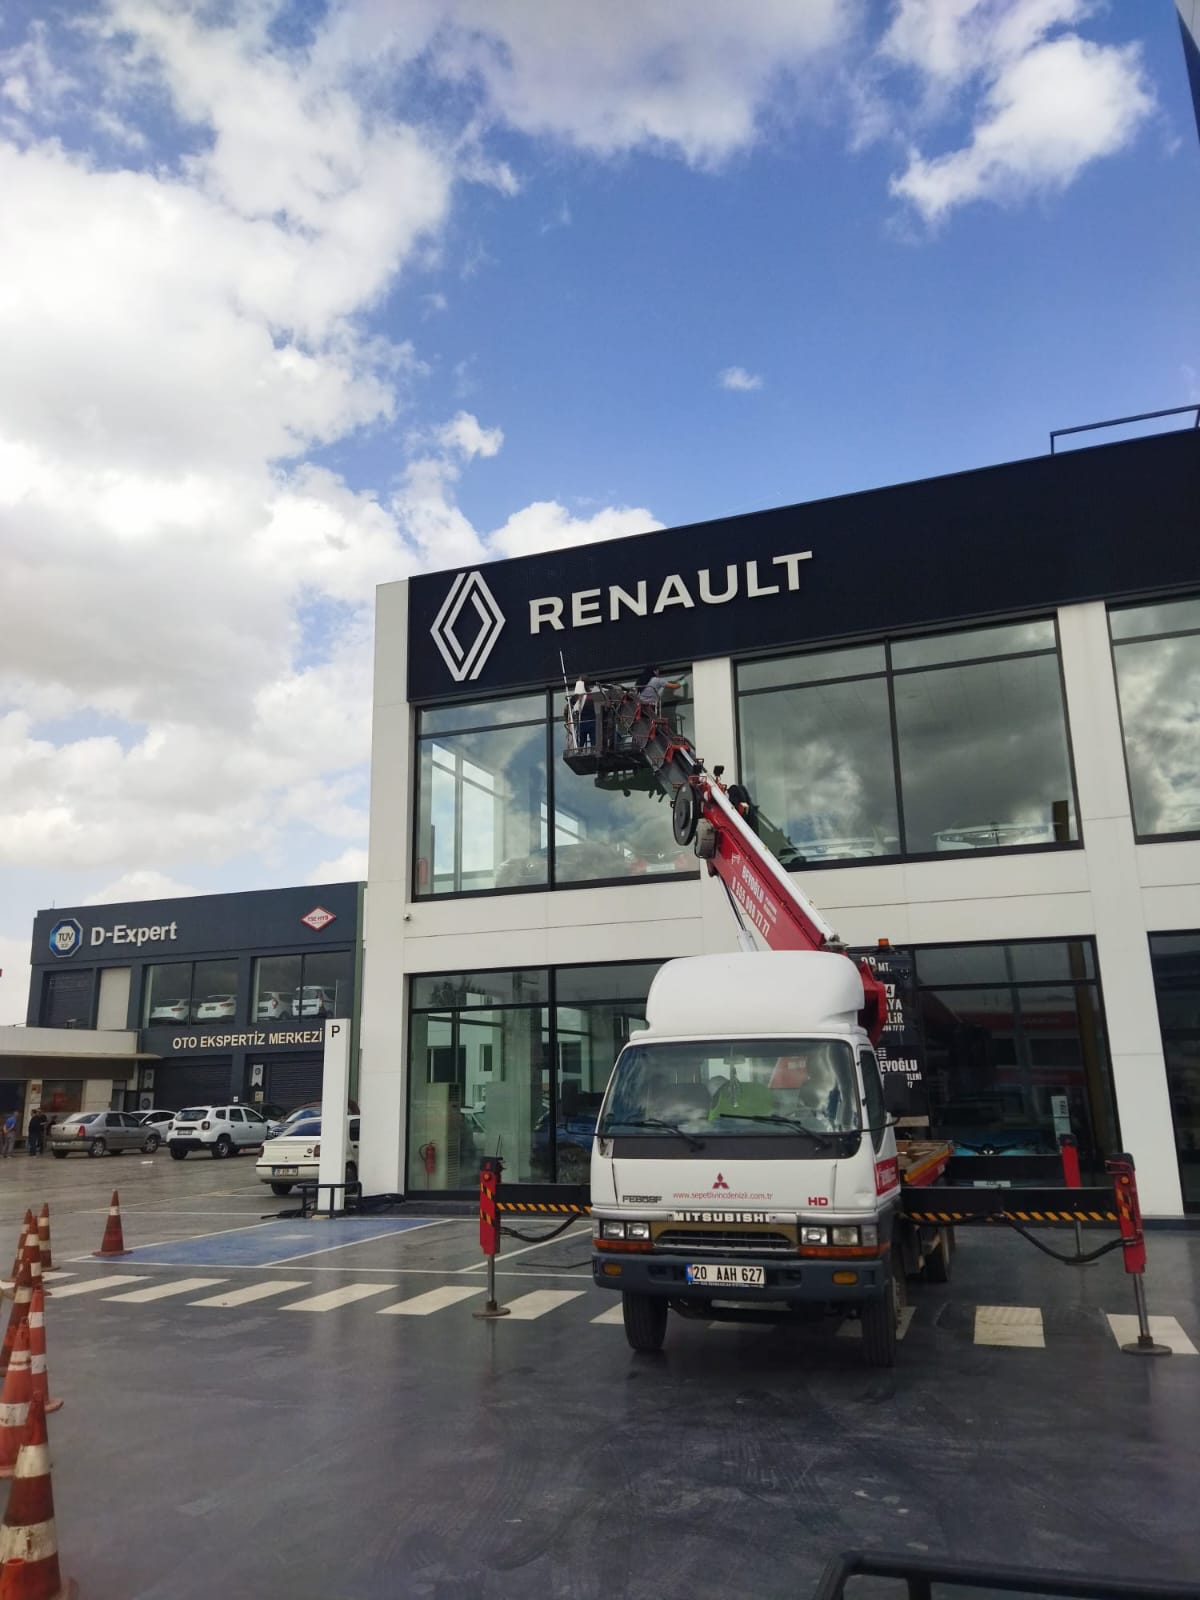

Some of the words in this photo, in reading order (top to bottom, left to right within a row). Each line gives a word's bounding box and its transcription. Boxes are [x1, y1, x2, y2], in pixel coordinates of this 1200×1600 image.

[529, 550, 813, 634] RENAULT
[90, 921, 178, 947] D-Expert
[172, 1037, 198, 1049] OTO
[200, 1030, 265, 1048] EKSPERTİZ
[268, 1027, 323, 1045] MERKEZİ
[331, 1025, 341, 1037] P
[808, 1197, 828, 1206] HD
[673, 1212, 770, 1223] MITSUBISHI
[694, 1266, 707, 1280] 20
[717, 1267, 737, 1281] AAH
[742, 1268, 762, 1282] 627
